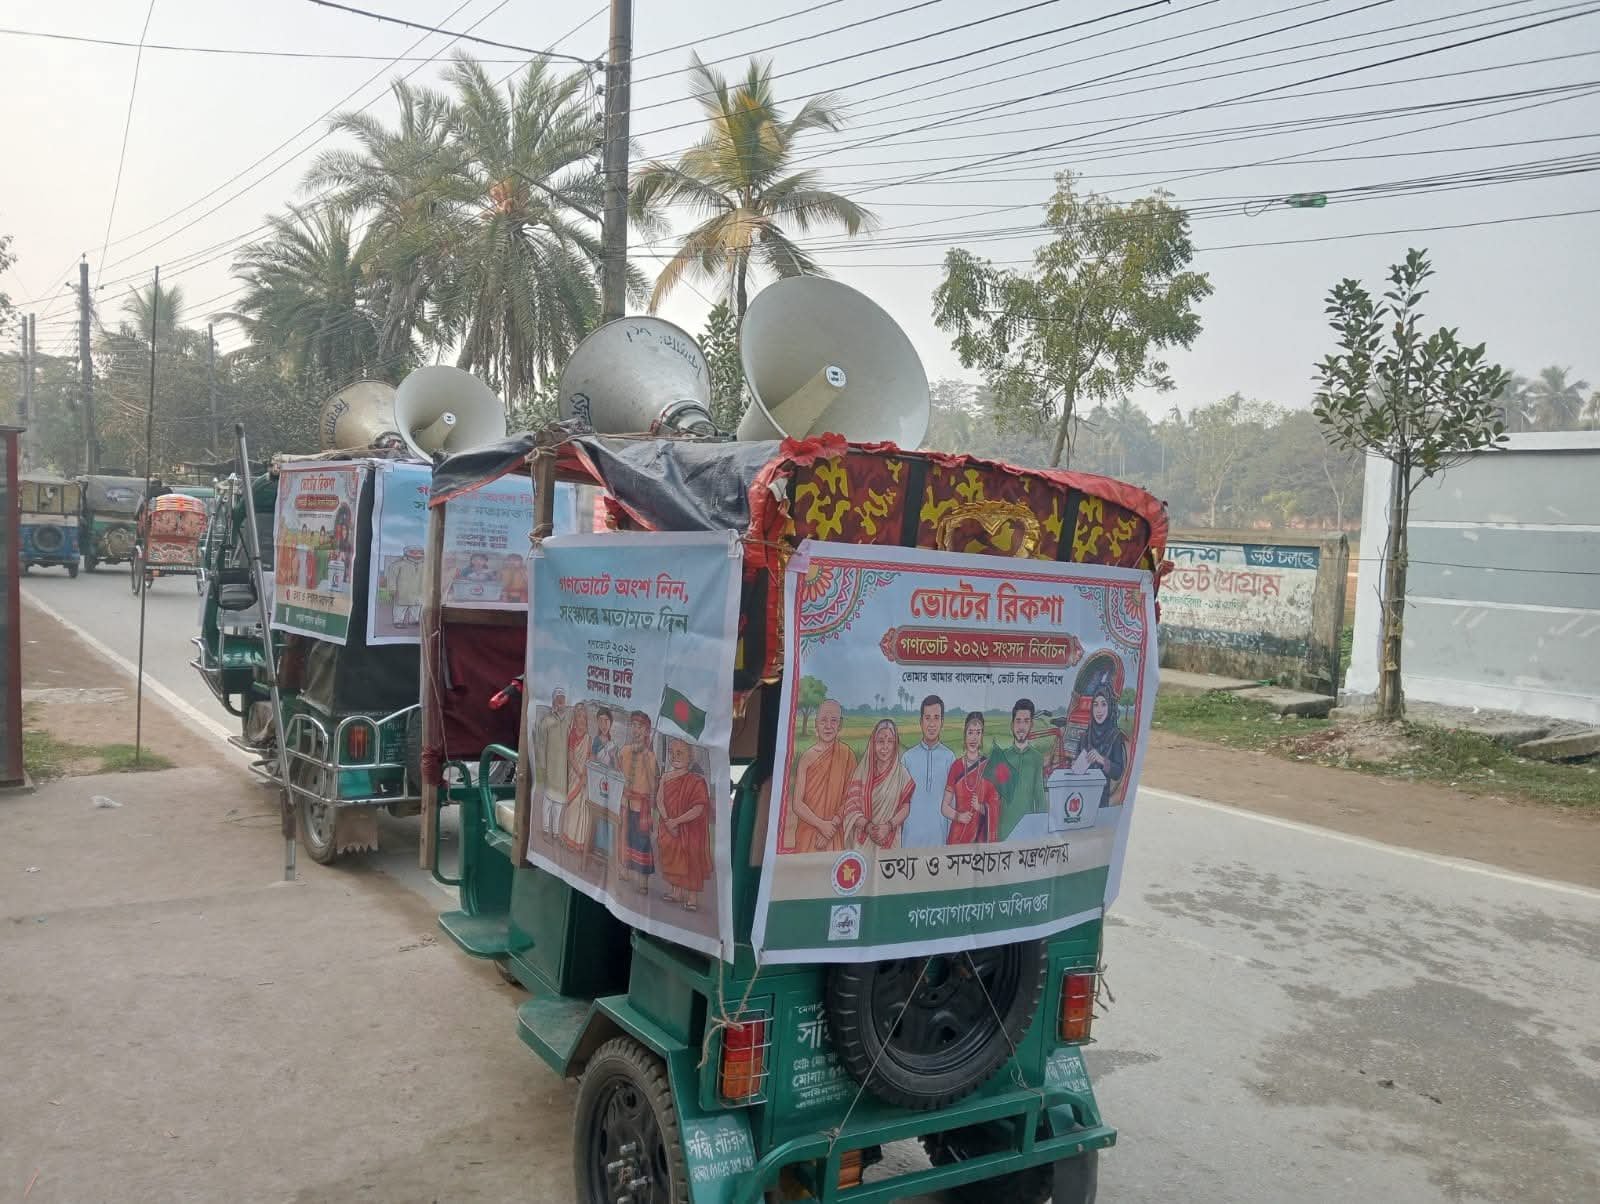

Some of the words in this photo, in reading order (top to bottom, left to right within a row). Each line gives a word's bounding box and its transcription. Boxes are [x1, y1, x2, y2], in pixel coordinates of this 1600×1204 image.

[559, 572, 610, 596] গণভোটে
[615, 578, 652, 599] অংশ
[656, 572, 688, 603] নিন,
[910, 579, 989, 622] ভোটের
[996, 582, 1065, 625] রিকশা
[560, 605, 599, 625] সংস্কারে
[601, 607, 655, 629] মতামত
[658, 605, 688, 634] দিন
[901, 634, 949, 656] গণভোট
[953, 640, 989, 658] ২০২৬
[993, 642, 1025, 657] সংসদ
[1029, 638, 1068, 659] নির্বাচন
[902, 672, 928, 683] তোমার
[930, 672, 953, 684] আমার
[998, 673, 1015, 685] ভোট
[1031, 672, 1063, 686] মিলেমিশে
[878, 856, 919, 880] তথ্য
[926, 857, 940, 876] ও
[947, 851, 1013, 876] সম্প্রচার
[1018, 842, 1070, 868] মন্ত্রণালয়
[908, 900, 996, 928] গণযোগাযোগ
[998, 892, 1049, 917] অধিদপ্তর
